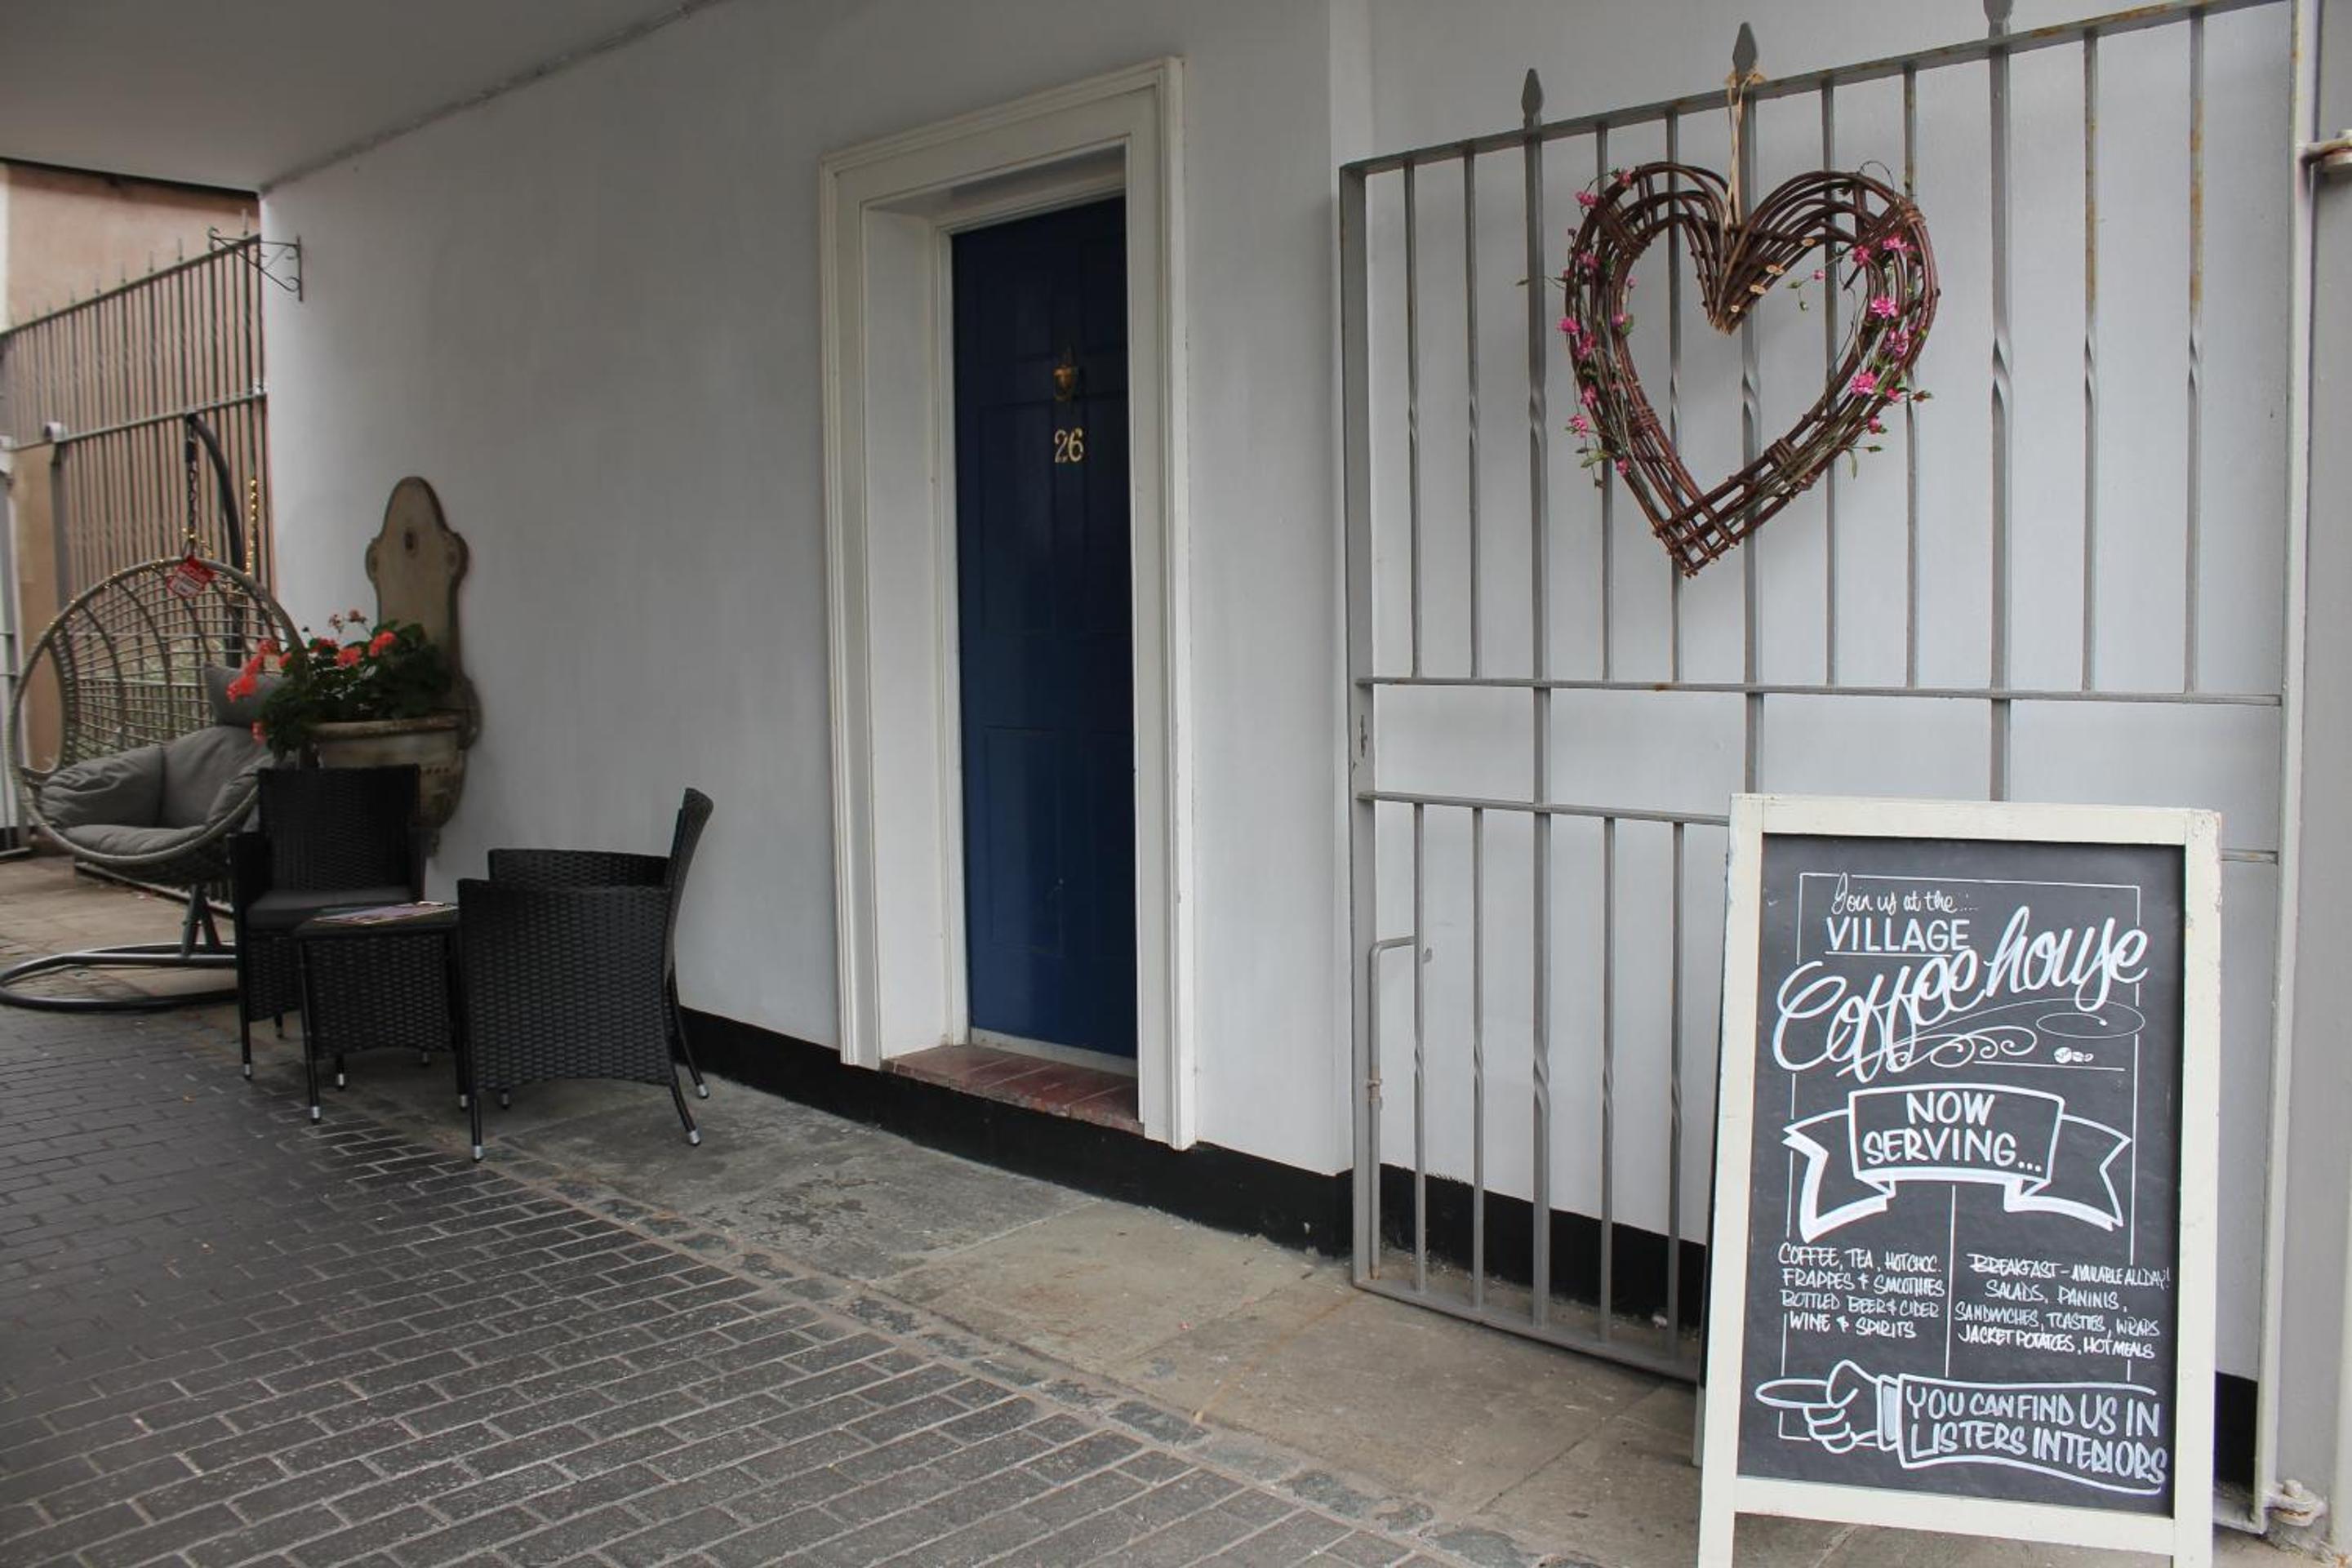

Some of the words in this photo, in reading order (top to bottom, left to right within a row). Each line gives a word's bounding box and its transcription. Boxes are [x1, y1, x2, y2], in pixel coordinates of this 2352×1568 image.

[1055, 428, 1083, 463] 26
[1831, 872, 1873, 914] Join
[1878, 891, 1897, 915] us
[1903, 891, 1921, 911] at
[1826, 917, 1970, 952] VILLAGE
[1772, 949, 1986, 1082] Coffee
[1983, 905, 2148, 1011] house
[1905, 1091, 1995, 1126] NOW
[1782, 1268, 1855, 1290] FRAPPES
[1874, 1274, 1945, 1297] SMOOTHIES
[1966, 1253, 2063, 1278] BREAKFAST
[2070, 1264, 2123, 1285] AVAILABLE
[1780, 1290, 1840, 1310] BOTTLED
[1847, 1295, 1886, 1314] BEER
[1900, 1300, 1939, 1317] CIDER
[1790, 1310, 1830, 1332] WINE
[1856, 1317, 1917, 1339] SPIRITS
[1958, 1324, 2015, 1346] JACKET
[2083, 1336, 2113, 1355] HOT
[2112, 1340, 2155, 1358] MEALS
[2116, 1317, 2160, 1336] WRAPS
[1906, 1386, 1965, 1420] YOU
[1968, 1392, 2014, 1418] CAN
[2016, 1393, 2074, 1426] FIND
[2080, 1393, 2118, 1435] US
[2126, 1398, 2160, 1437] IN
[1910, 1420, 2028, 1459] LISTERS
[2032, 1427, 2167, 1484] INTERIORS
